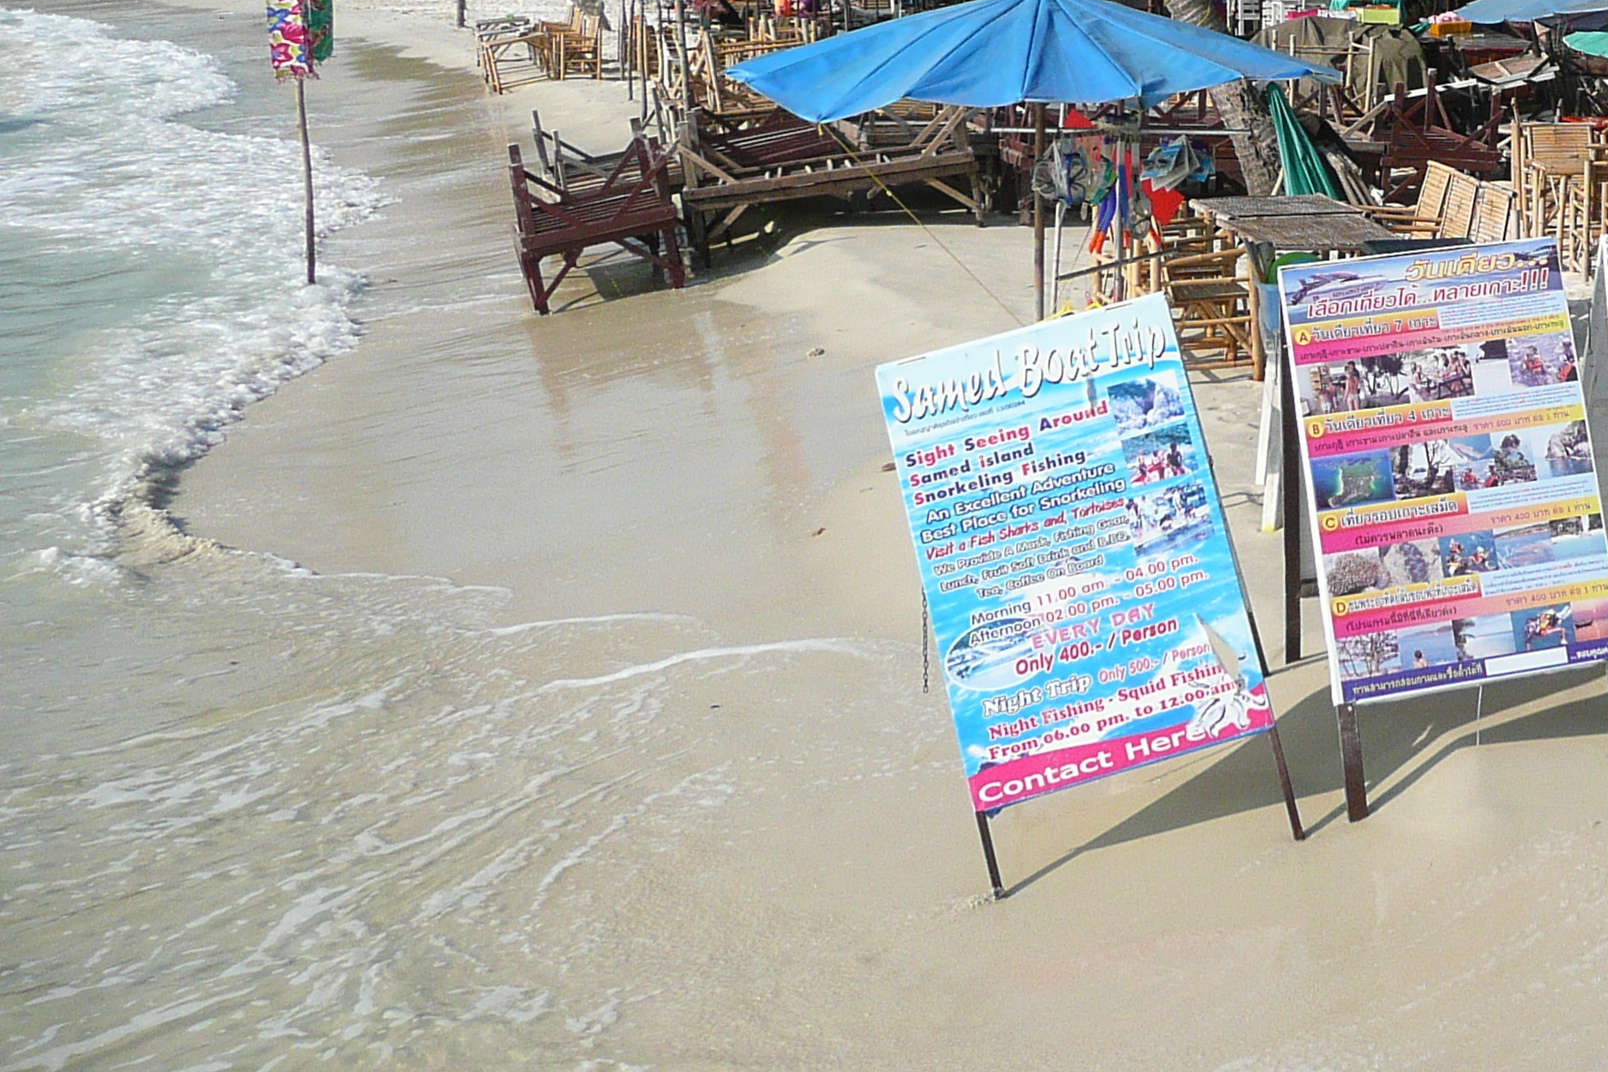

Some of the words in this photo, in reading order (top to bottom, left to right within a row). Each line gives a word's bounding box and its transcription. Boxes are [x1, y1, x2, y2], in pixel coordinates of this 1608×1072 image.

[1298, 331, 1308, 342] A
[1395, 320, 1402, 331] 7
[893, 349, 1008, 423] Samed
[1015, 328, 1099, 397] Boat
[1101, 316, 1167, 369] Trip
[904, 441, 955, 467] Sight
[963, 426, 1030, 451] Seeing
[1037, 400, 1108, 431] Around
[1311, 423, 1320, 434] B
[1407, 410, 1415, 420] 4
[909, 460, 971, 487] Samed
[979, 442, 1034, 469] island
[913, 470, 1014, 504] Snorkeling
[1021, 451, 1086, 475] Fishing
[920, 522, 957, 544] Best
[961, 512, 1007, 533] Place
[1010, 504, 1035, 519] for
[1039, 479, 1127, 509] Snorkeling
[925, 509, 950, 524] An
[953, 483, 1027, 516] Excellent
[1030, 464, 1116, 495] Adventure
[926, 541, 955, 560] Visit
[958, 541, 966, 550] a
[969, 530, 995, 548] Fish
[998, 520, 1039, 540] Sharks
[1043, 512, 1067, 526] and,
[1071, 498, 1125, 520] Tortoises
[933, 563, 954, 576] We
[956, 550, 1001, 570] Provide
[1003, 545, 1013, 557] A
[1014, 535, 1051, 551] Mask,
[1053, 525, 1095, 542] Fishing
[1096, 516, 1130, 529] Gear,
[1325, 517, 1336, 529] C
[940, 573, 979, 590] Lunch,
[981, 563, 1009, 581] Fruit
[1009, 556, 1035, 572] Soft
[1036, 546, 1069, 565] Drink
[1071, 539, 1096, 555] and
[969, 601, 1032, 624] Morning
[1036, 586, 1076, 607] 11.00
[1081, 580, 1109, 594] am.
[1125, 561, 1166, 582] 04.00
[1171, 555, 1199, 571] pm.
[976, 585, 1003, 597] Tea,
[1004, 573, 1045, 591] Coffee
[1046, 567, 1066, 579] On
[1066, 554, 1104, 574] Board
[969, 618, 1041, 645] Afternoon
[1045, 602, 1087, 623] 02.00
[1091, 596, 1119, 613] pm.
[1135, 577, 1176, 598] 05.00
[1180, 570, 1209, 587] pm.
[1031, 618, 1101, 650] EVERY
[1112, 603, 1156, 627] DAY
[1336, 602, 1346, 614] D
[1014, 654, 1055, 675] Only
[1058, 640, 1102, 663] 400.-
[1121, 621, 1178, 645] Person
[981, 684, 1042, 715] Night
[1044, 675, 1093, 697] Trip
[1097, 666, 1127, 683] Only
[1171, 643, 1210, 662] Person
[988, 715, 1037, 739] Night
[1041, 698, 1105, 723] Fishing
[1116, 677, 1166, 700] Squid
[989, 740, 1039, 761] From
[1042, 720, 1091, 745] 06.00
[1095, 711, 1130, 732] pm.
[1134, 706, 1154, 719] to
[1159, 688, 1206, 711] 12.00
[978, 751, 1113, 803] Contact
